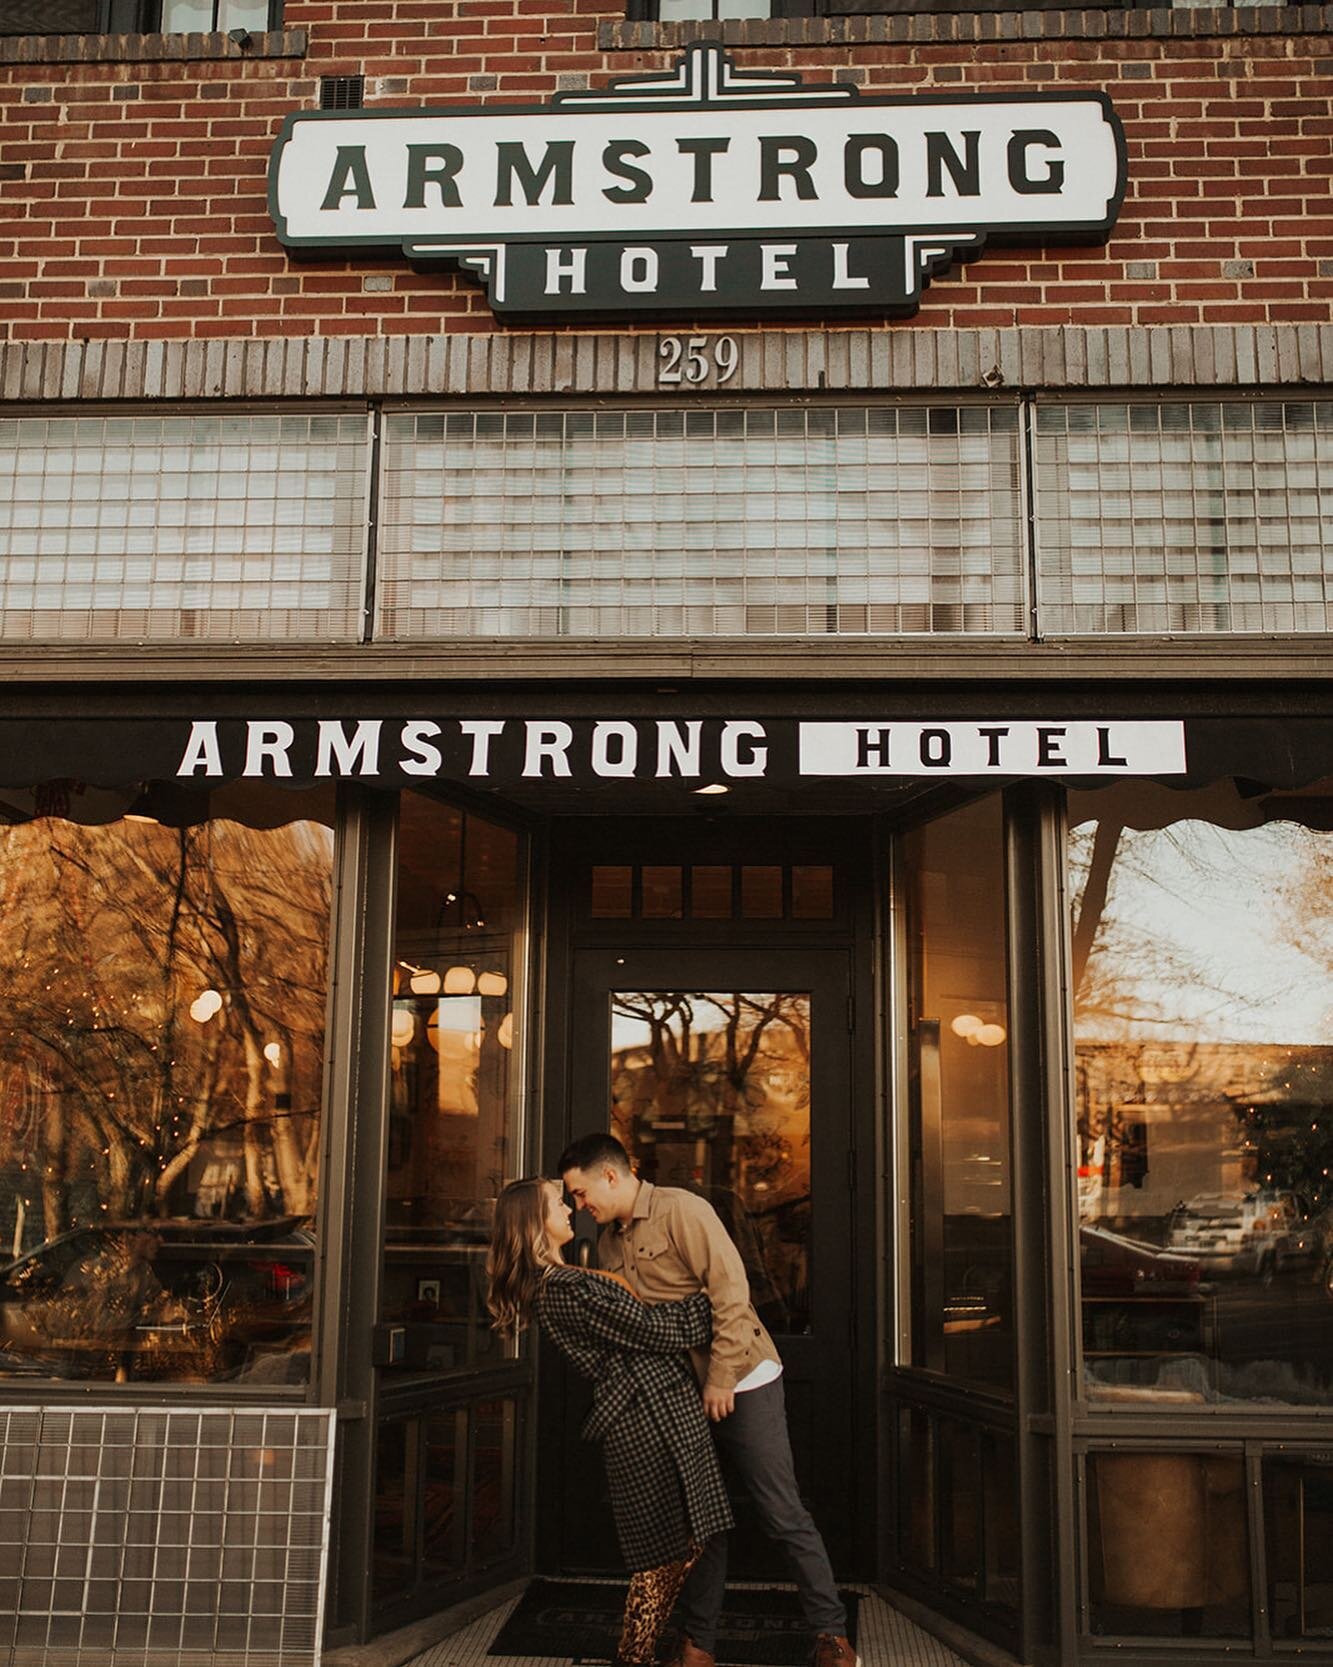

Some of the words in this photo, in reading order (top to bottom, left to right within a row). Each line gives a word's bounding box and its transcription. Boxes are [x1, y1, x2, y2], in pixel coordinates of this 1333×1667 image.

[319, 128, 1065, 211] ARMSTRONG
[543, 243, 870, 295] HOTEL
[658, 336, 739, 384] 259
[176, 720, 768, 778] ARMSTRONG
[855, 728, 1128, 768] HOTEL
